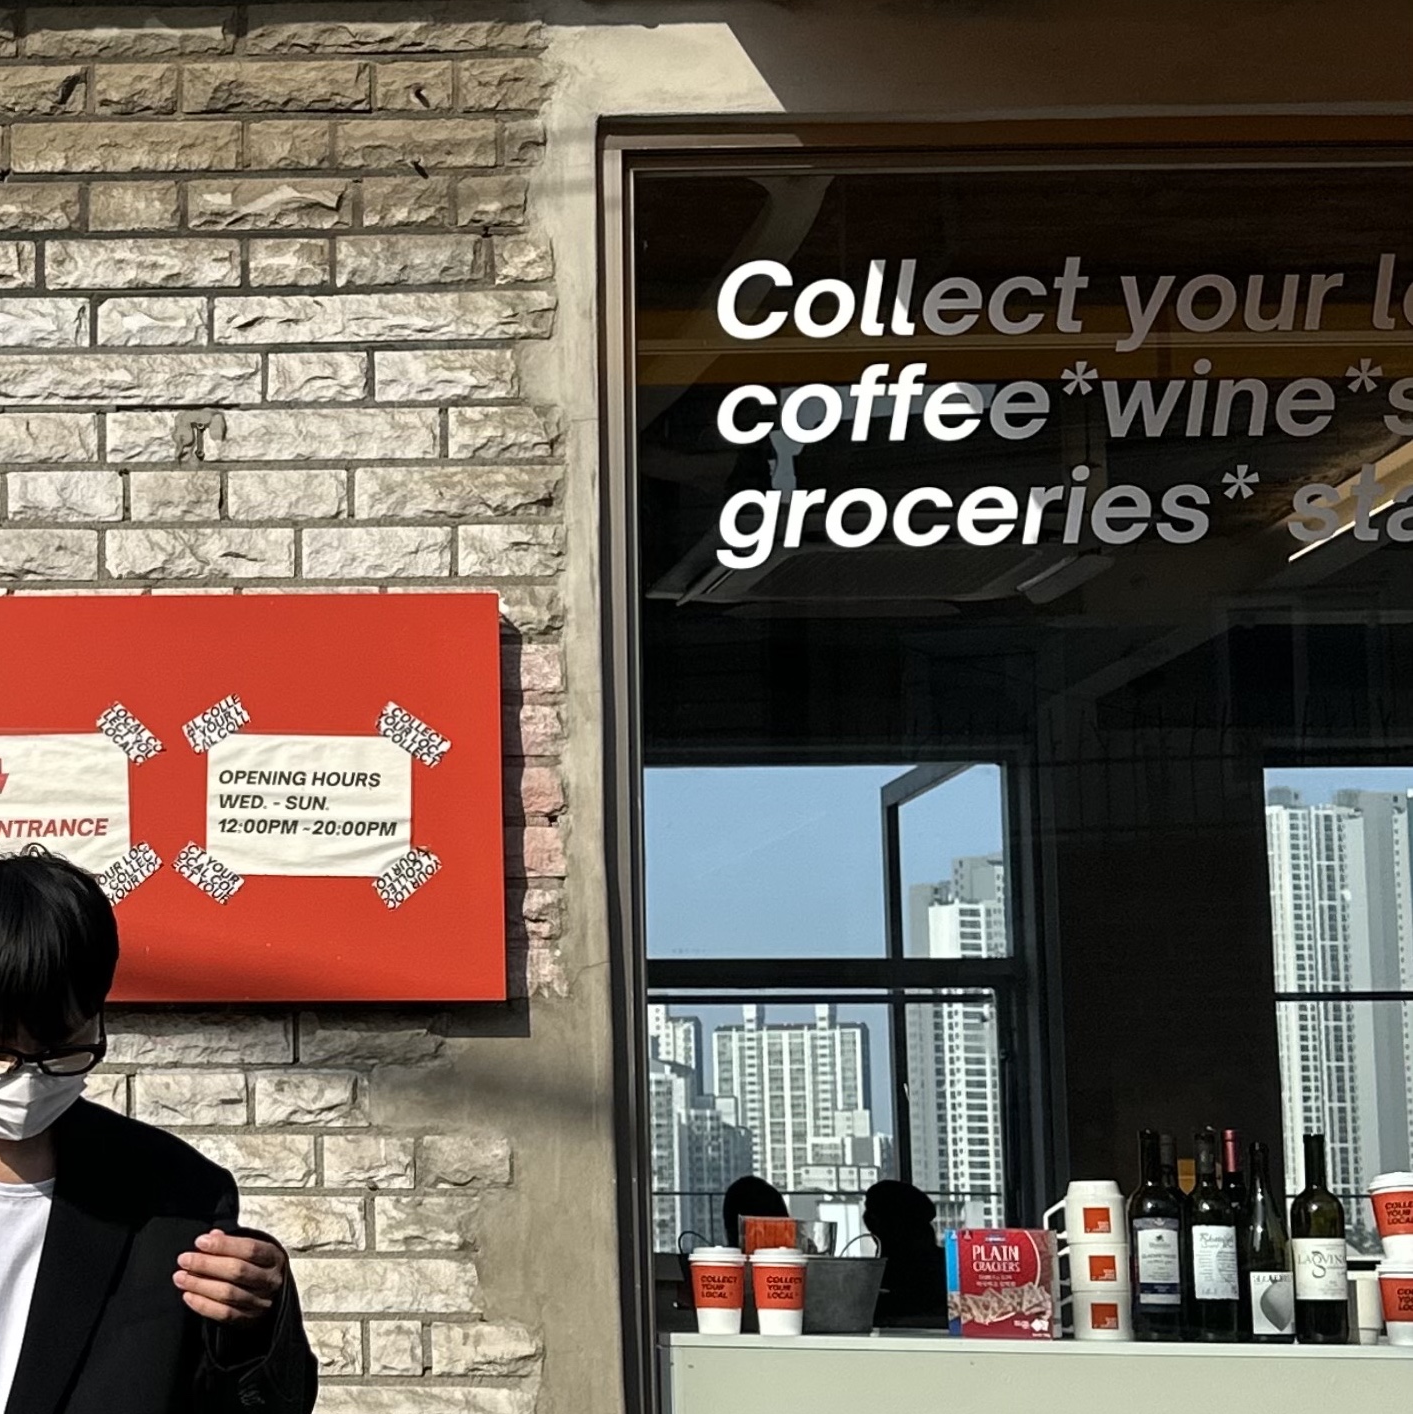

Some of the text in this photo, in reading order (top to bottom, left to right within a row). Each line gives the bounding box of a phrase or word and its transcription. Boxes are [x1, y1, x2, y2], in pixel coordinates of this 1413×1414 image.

[717, 252, 1413, 352] Collect your l
[391, 707, 448, 747] COLLECT
[218, 769, 381, 788] OPENING HOURS
[219, 793, 267, 809] WED.
[285, 795, 329, 811] SUN.
[218, 818, 299, 834] 12:00PM
[972, 1245, 1019, 1261] PLAIN
[972, 1261, 1021, 1273] CRACKERS
[700, 1275, 737, 1284] COLLECT
